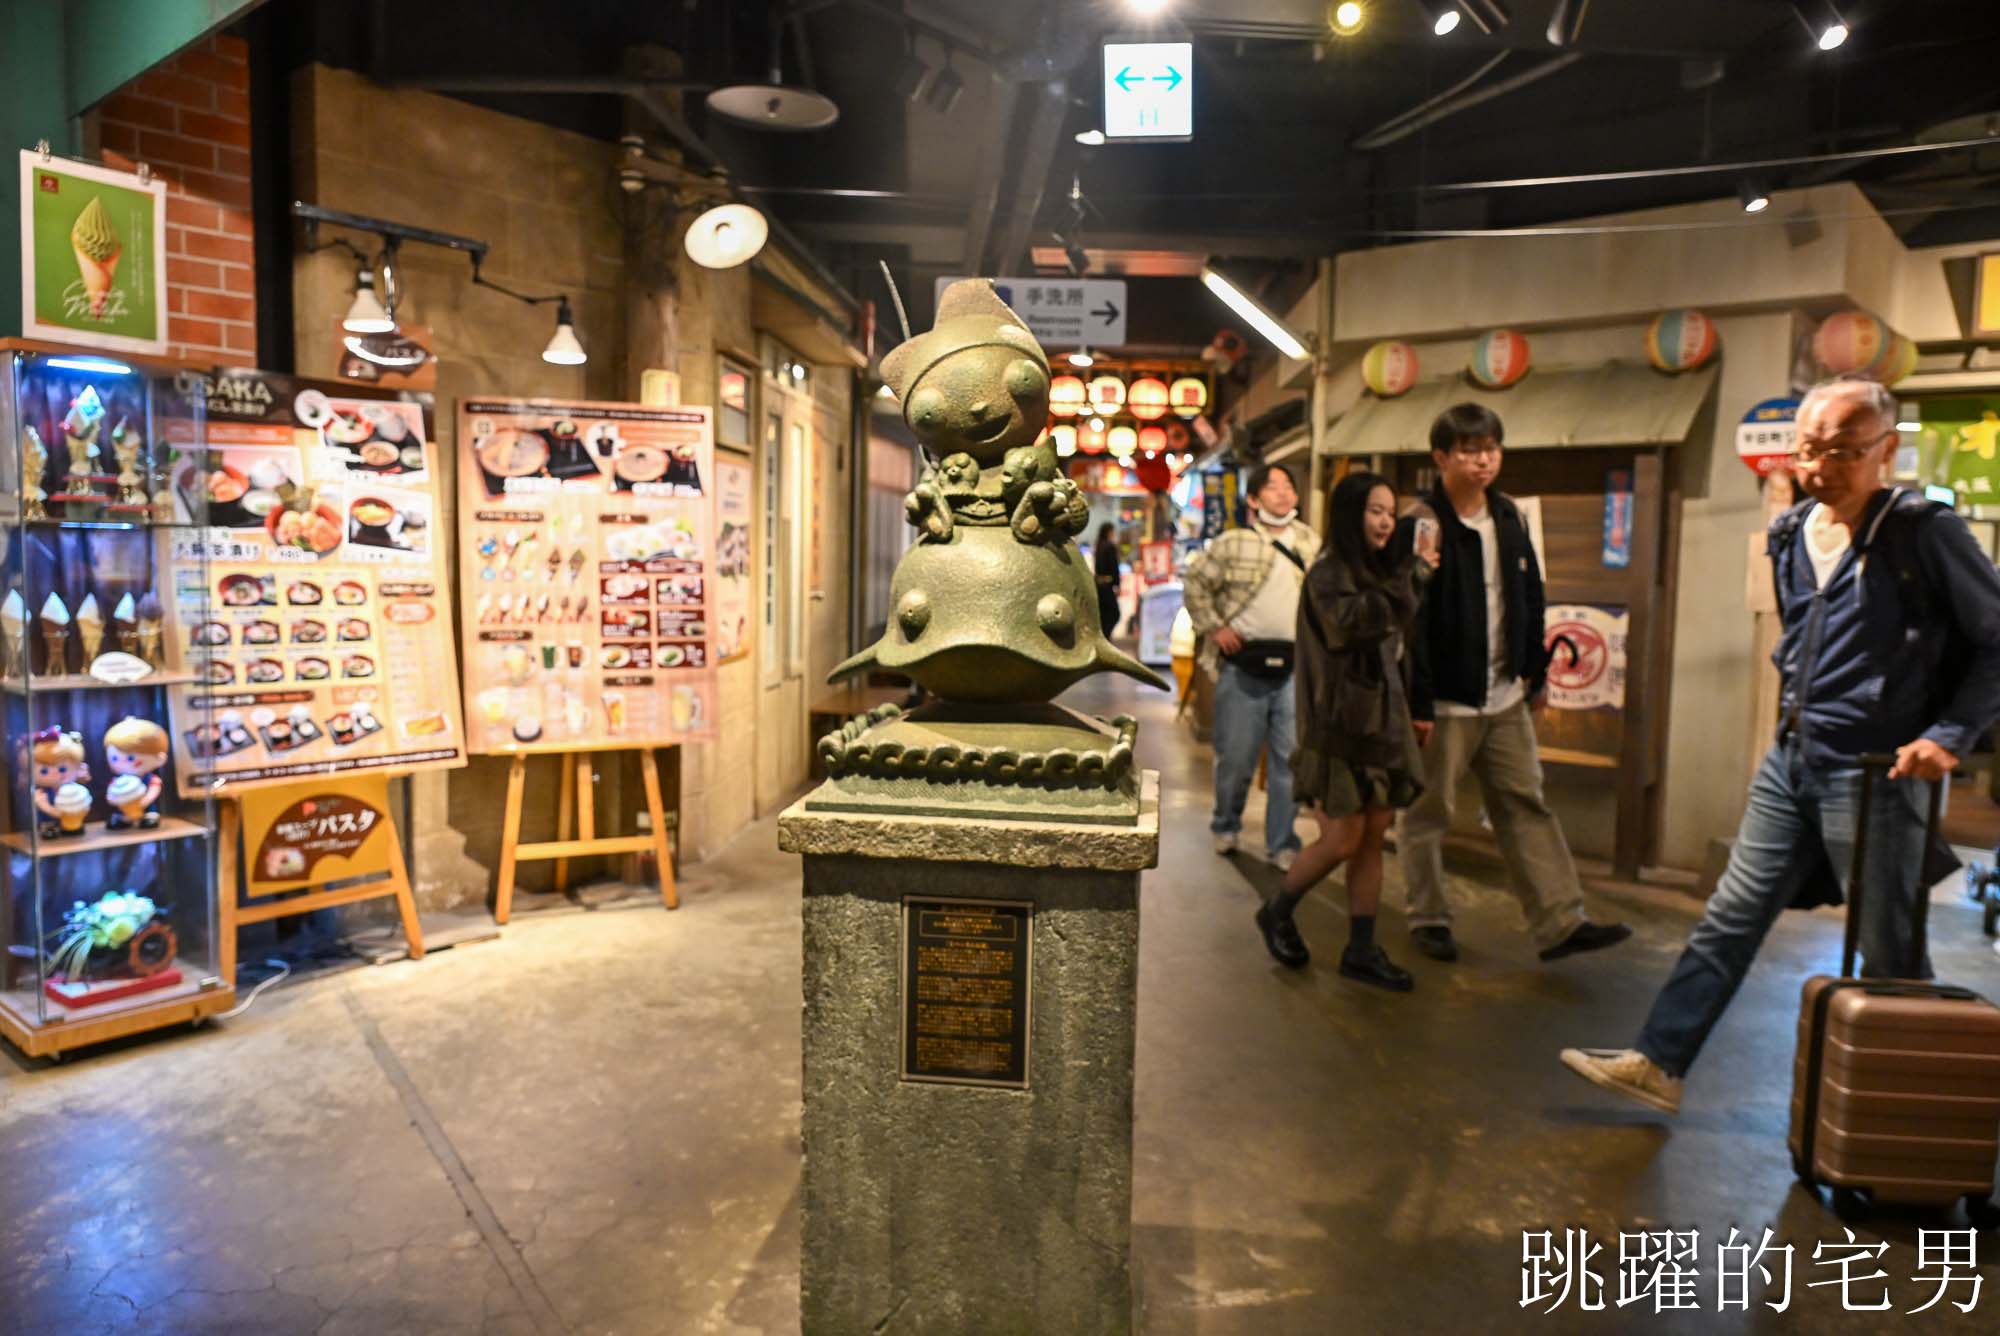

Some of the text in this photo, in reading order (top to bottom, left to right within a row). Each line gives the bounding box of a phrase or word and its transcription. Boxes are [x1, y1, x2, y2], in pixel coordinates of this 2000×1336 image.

[1026, 287, 1083, 306] 手洗所
[174, 370, 273, 405] OSAKA
[316, 808, 376, 836] パスタ
